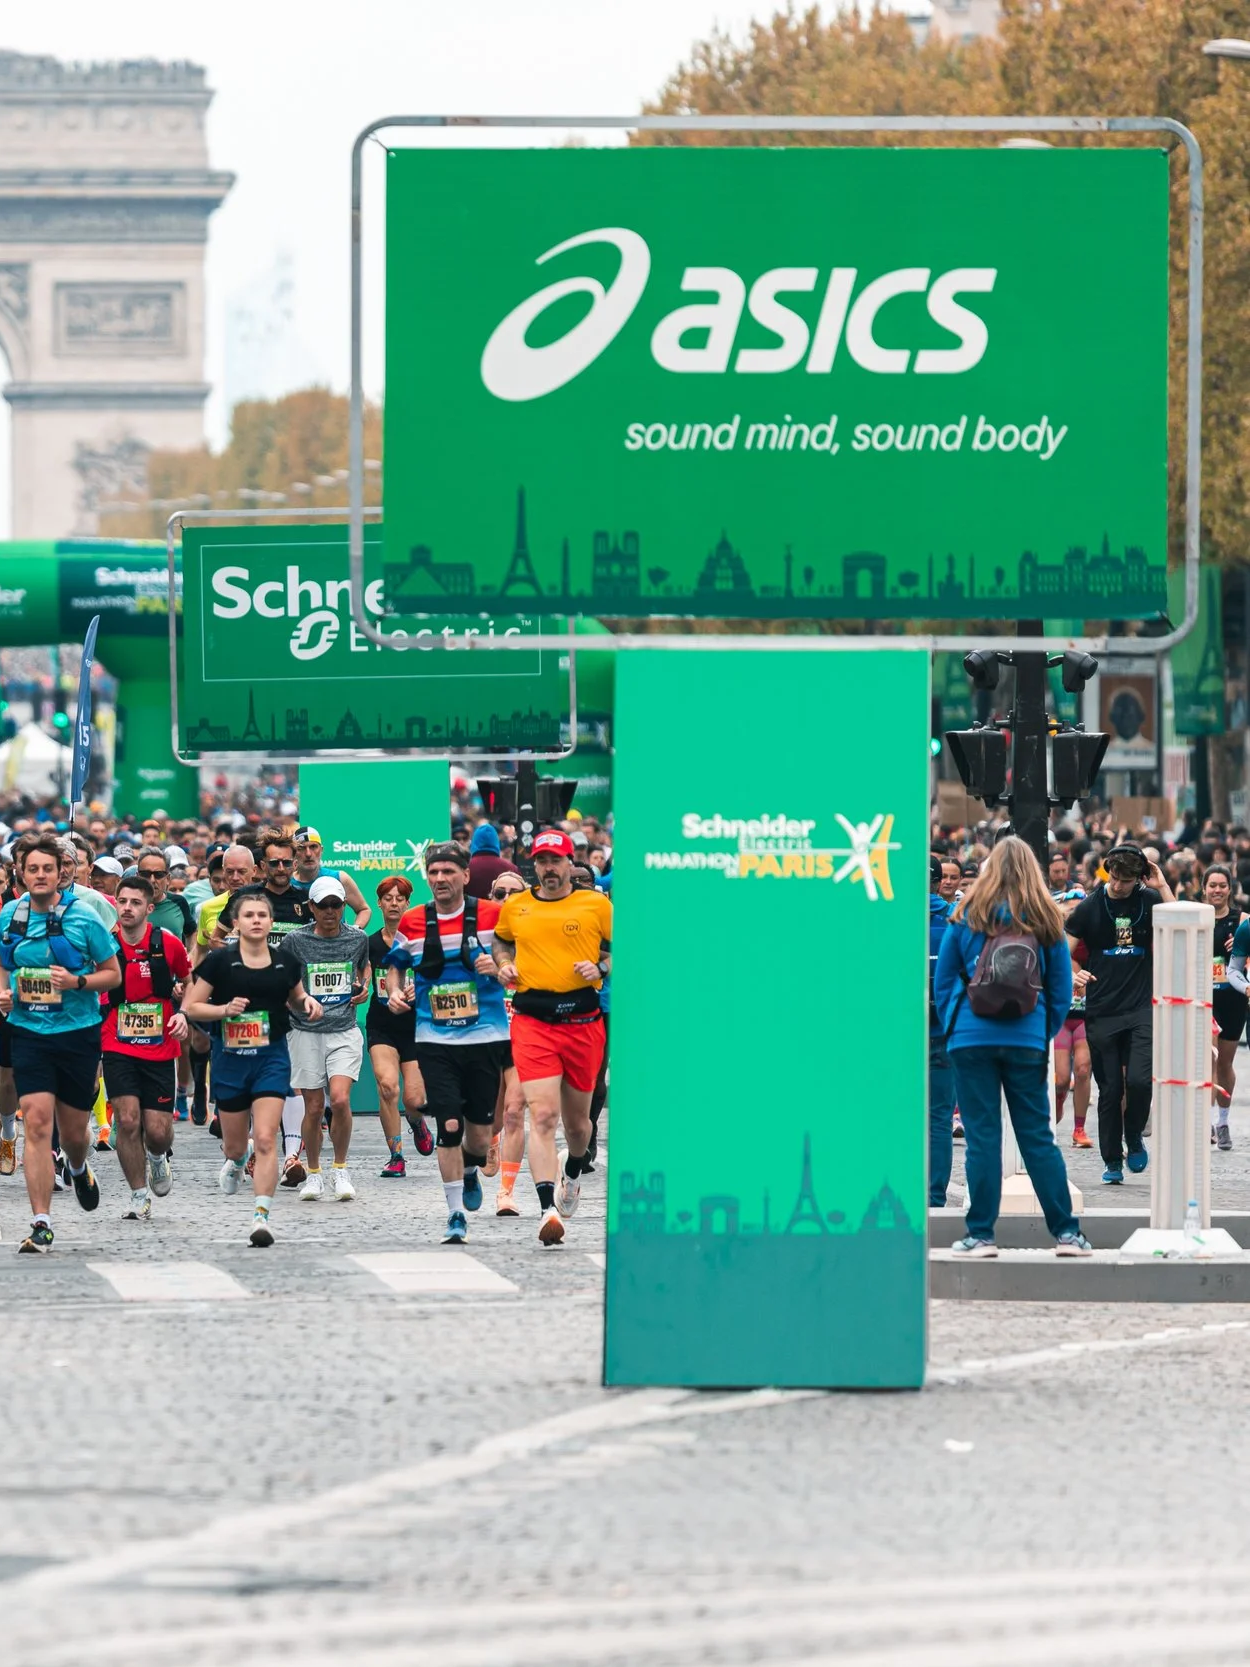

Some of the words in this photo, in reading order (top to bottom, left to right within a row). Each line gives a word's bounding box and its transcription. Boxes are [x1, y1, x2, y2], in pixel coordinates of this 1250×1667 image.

[624, 415, 741, 452] sound
[745, 415, 841, 455] mind,
[851, 415, 968, 453] sound
[971, 416, 1068, 461] body
[212, 565, 384, 618] Schne
[681, 812, 816, 838] Schneider
[333, 839, 397, 853] Schneider
[360, 858, 406, 871] PARIS
[644, 852, 740, 869] MARATHON
[739, 853, 835, 878] PARIS
[314, 973, 343, 987] 61007
[436, 994, 468, 1010] 62510
[124, 1014, 154, 1028] 47395
